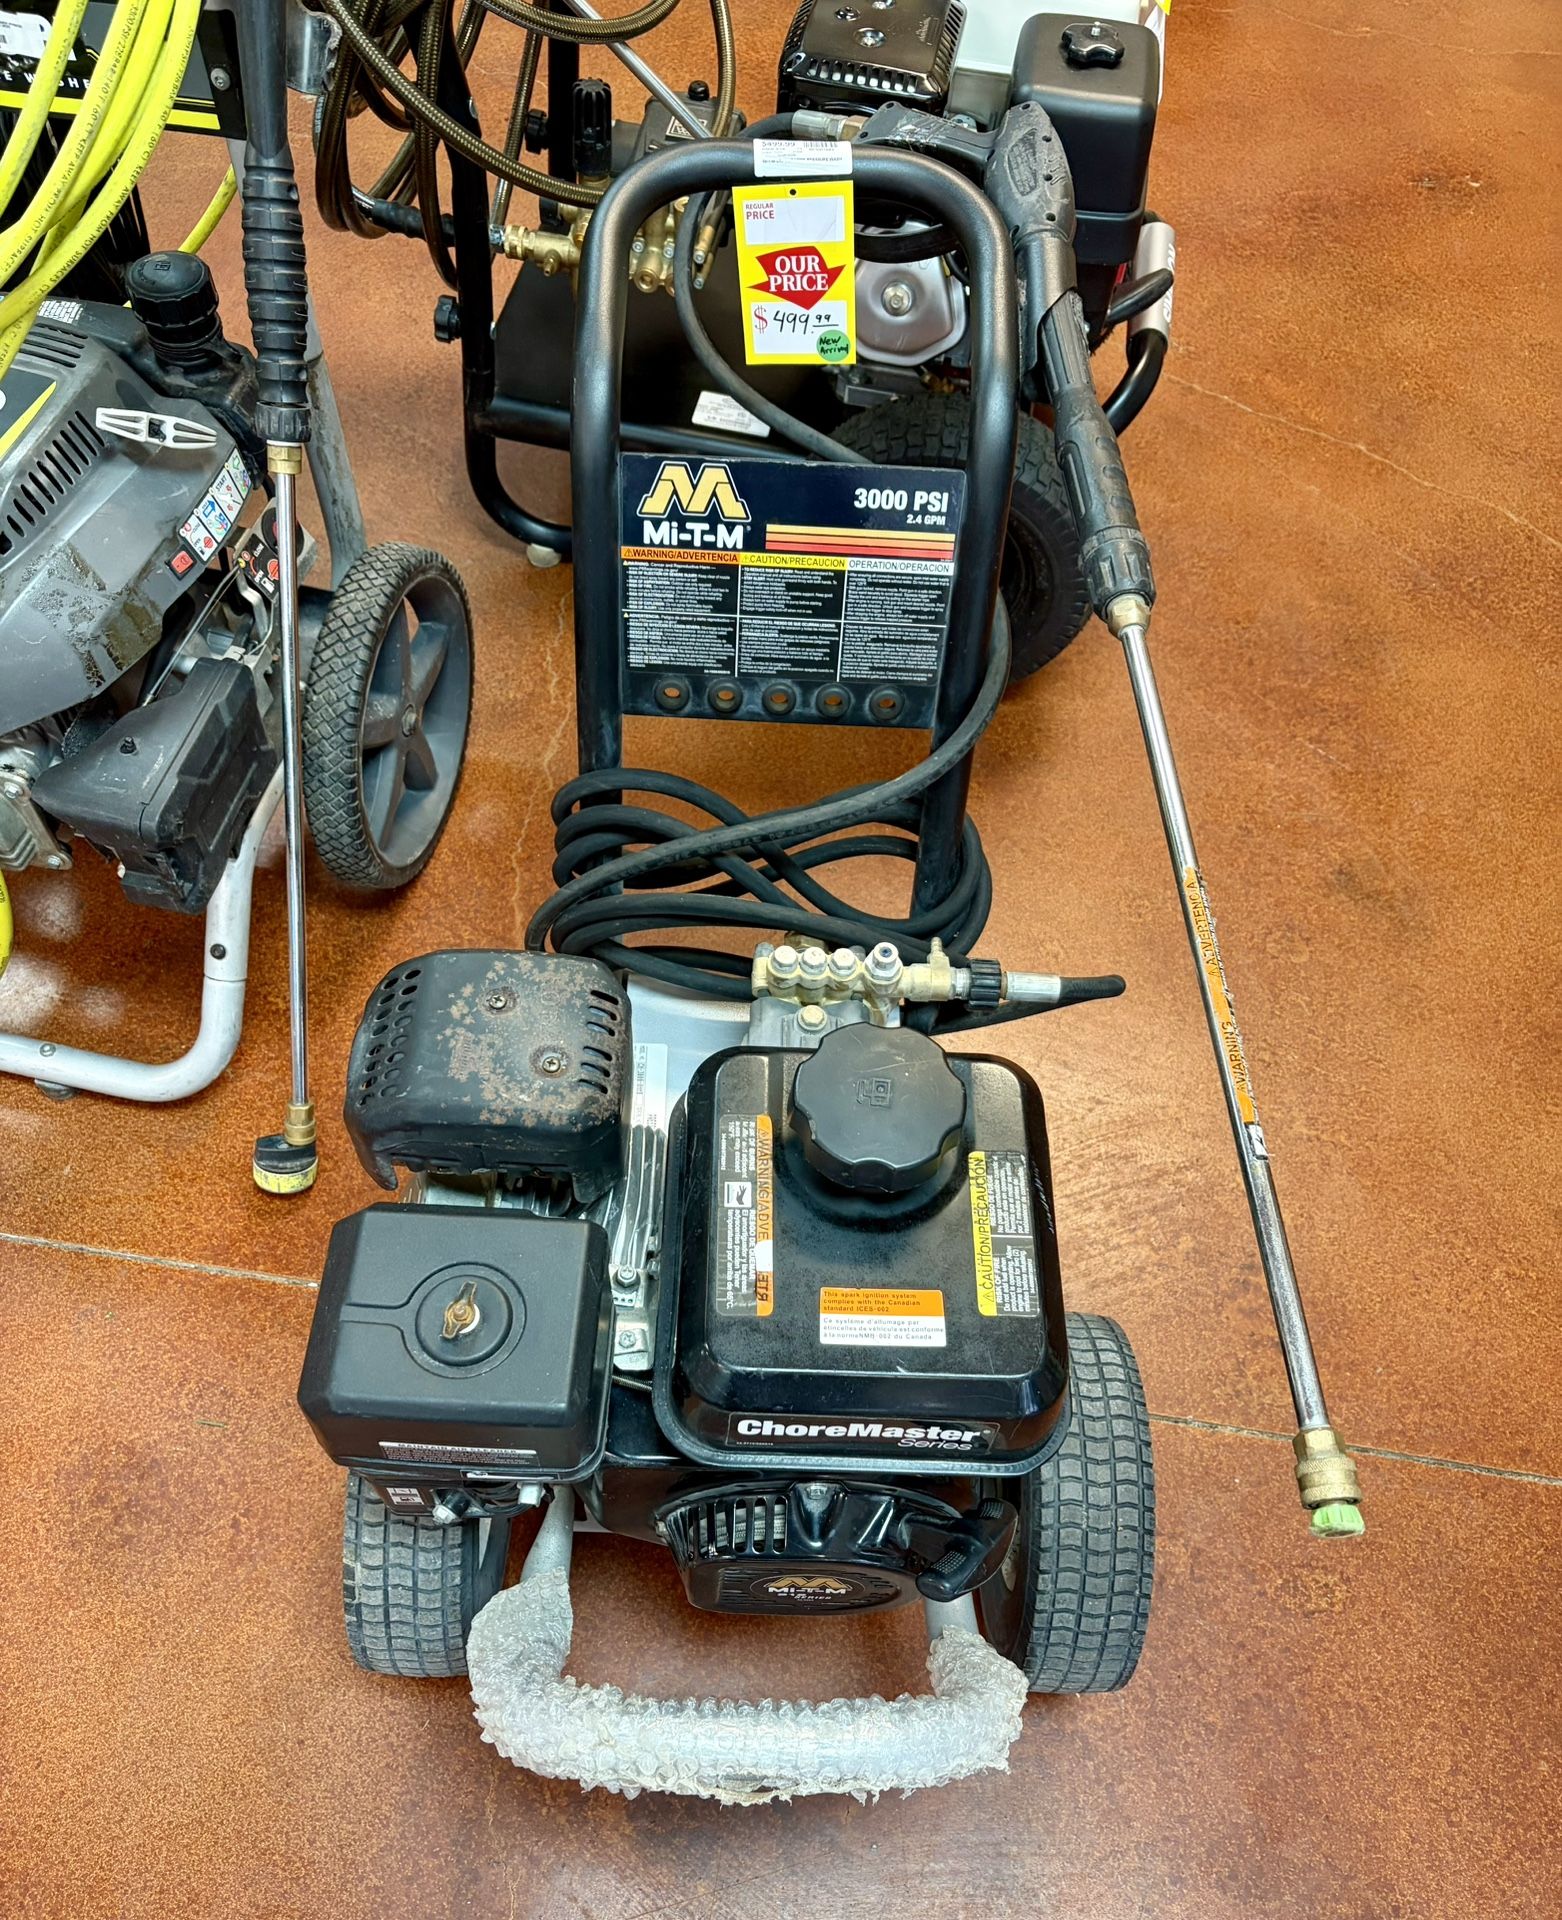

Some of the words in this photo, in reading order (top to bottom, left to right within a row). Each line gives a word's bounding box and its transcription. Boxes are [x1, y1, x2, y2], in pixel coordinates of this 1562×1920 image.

[111, 185, 130, 210] AWAY
[745, 202, 774, 210] REGULAR
[94, 208, 113, 234] FROM
[746, 210, 775, 220] PRICE
[80, 232, 97, 252] HOT
[48, 248, 82, 286] SURFACES
[775, 255, 821, 274] OUR
[769, 273, 829, 292] PRICE
[819, 336, 841, 345] New
[854, 487, 908, 511] 3000
[913, 491, 949, 513] PSI
[906, 514, 923, 525] 2.4
[924, 515, 946, 526] GPM
[642, 520, 744, 550] Mi-T-M
[632, 548, 738, 562] WARNING/ADVERTENCIA
[749, 554, 845, 568] CAUTION/PRECAUCION
[848, 559, 950, 573] OPERATION/OPERACION
[1221, 1021, 1248, 1084] WARNING
[987, 1194, 995, 1202] DE
[748, 1209, 756, 1236] RIESGO
[748, 1236, 755, 1247] DE
[732, 1245, 741, 1269] pueden
[747, 1248, 756, 1280] QUEMAR
[991, 1256, 1001, 1273] FIRE
[740, 1263, 748, 1273] las
[726, 1281, 733, 1290] de
[994, 1273, 1002, 1284] OF
[1014, 1275, 1022, 1286] cool
[994, 1285, 1003, 1303] RISK
[1002, 1293, 1010, 1302] not
[1003, 1302, 1011, 1311] Do
[737, 1419, 981, 1442] ChoreMaster
[897, 1438, 973, 1451] Series
